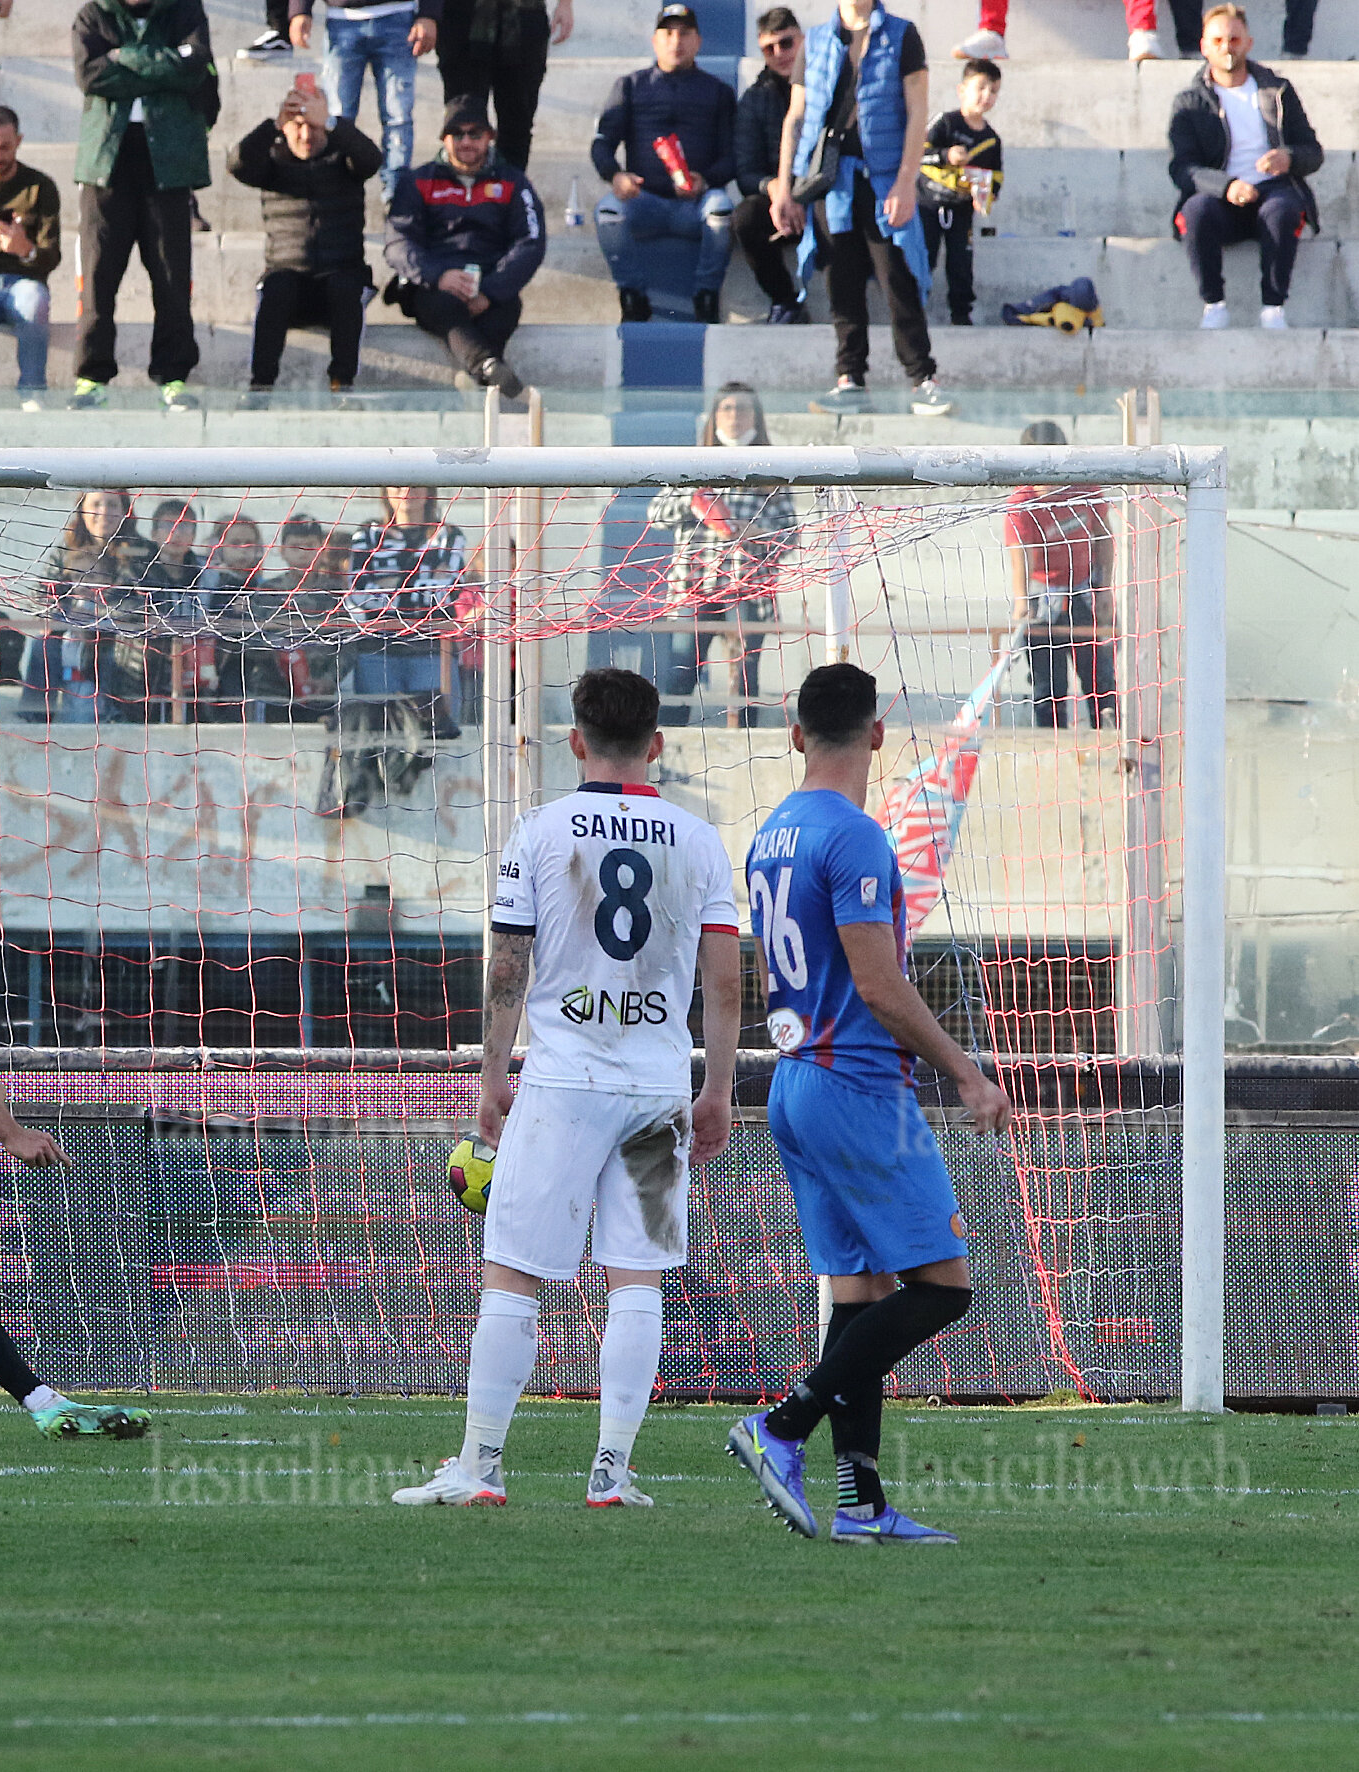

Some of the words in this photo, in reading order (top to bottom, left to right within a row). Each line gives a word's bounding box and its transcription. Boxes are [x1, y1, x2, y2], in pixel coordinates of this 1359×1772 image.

[571, 813, 676, 848] SANDRI
[594, 847, 654, 962] 8
[749, 866, 808, 993] 26
[597, 989, 668, 1026] NBS
